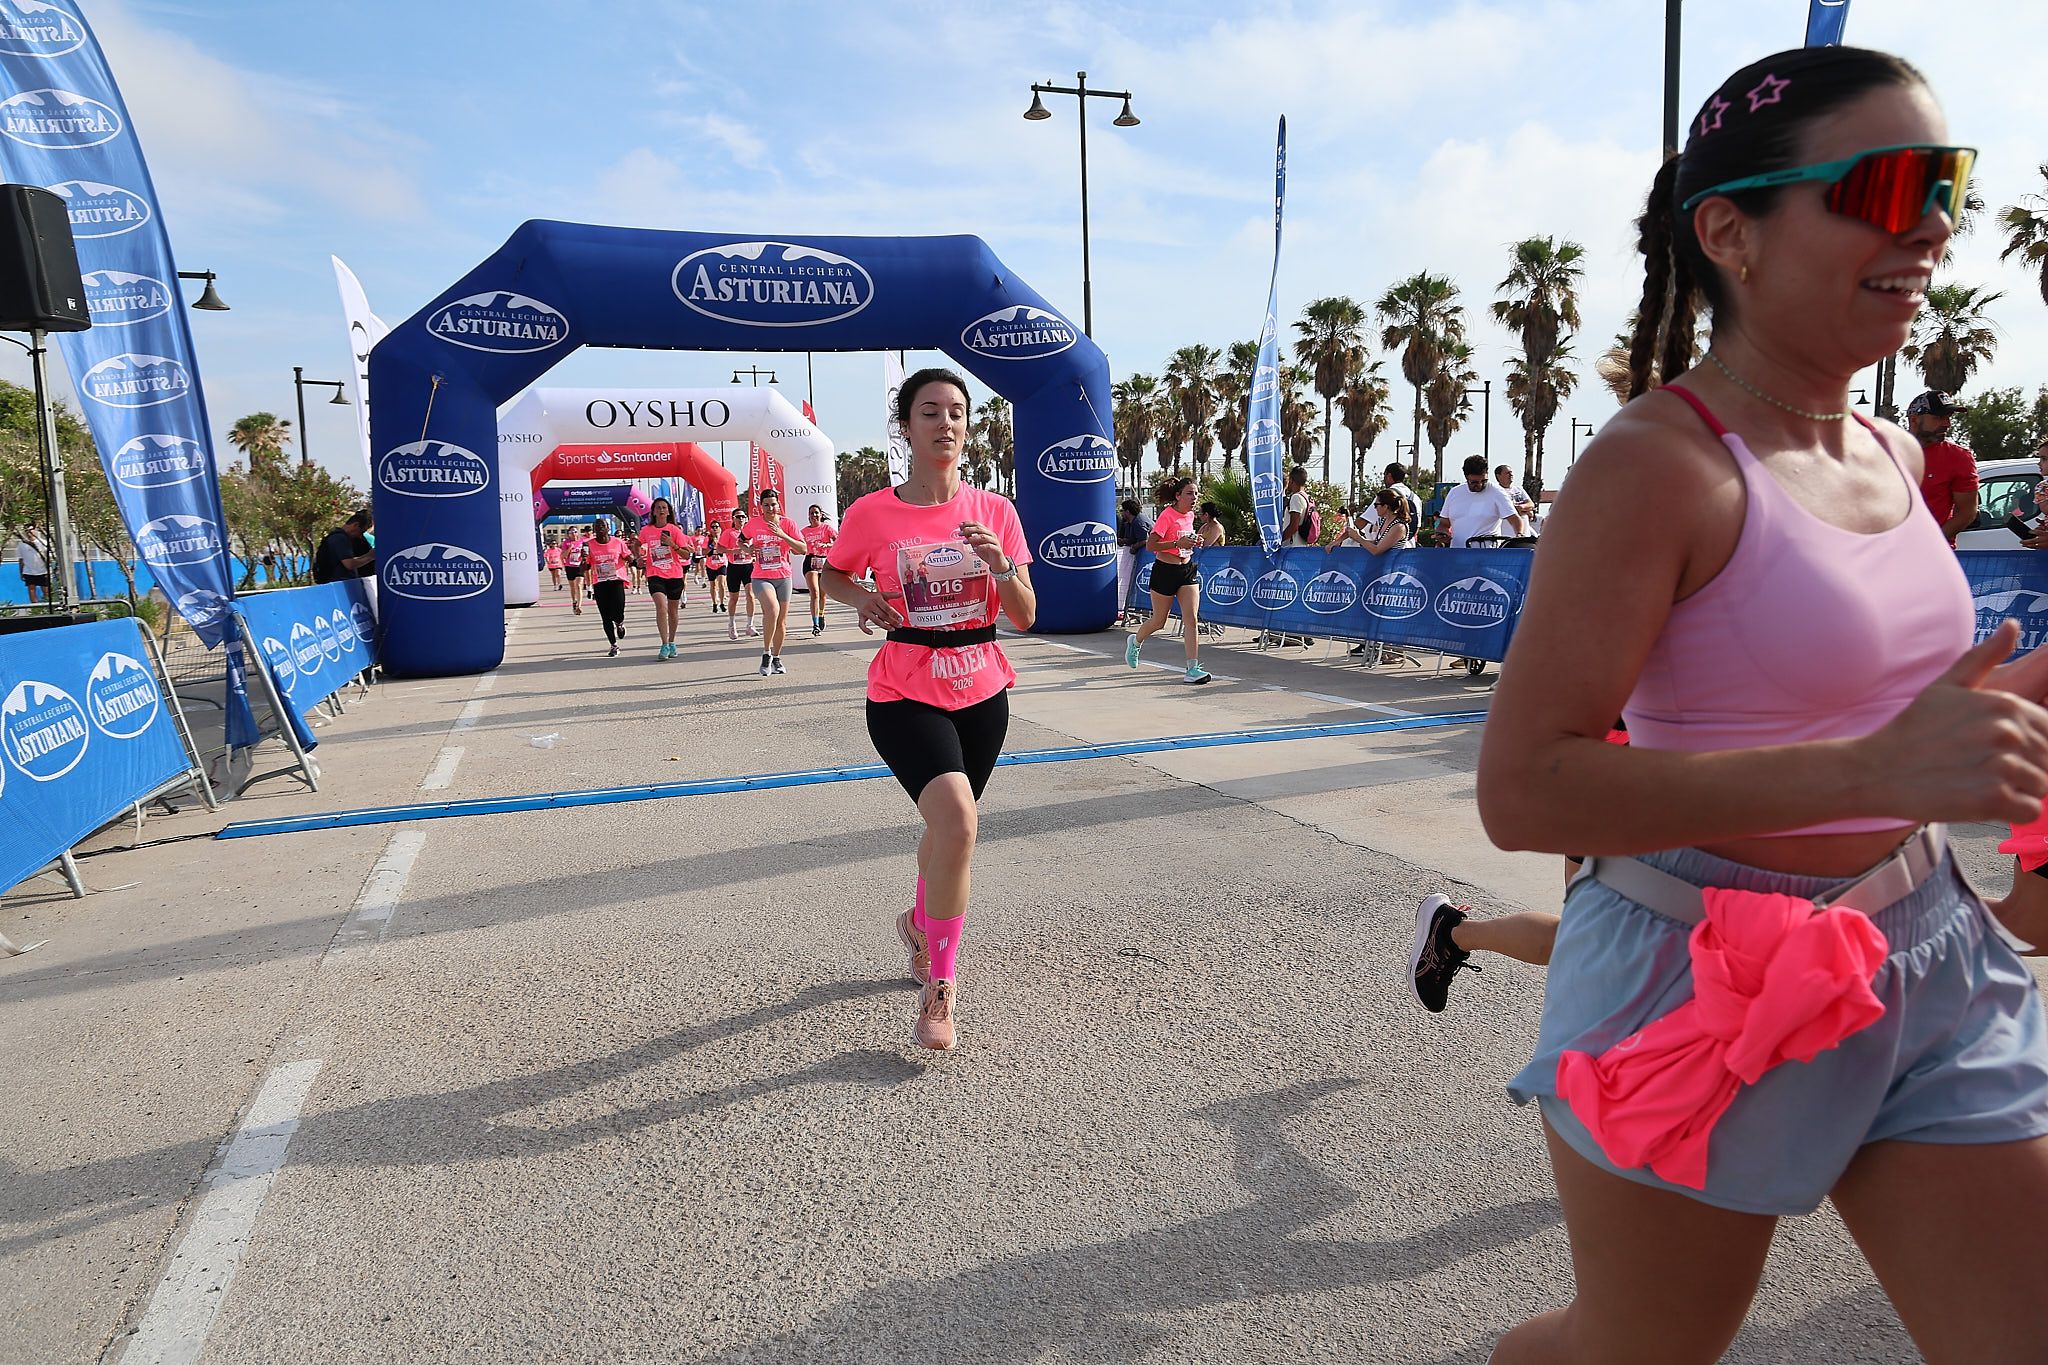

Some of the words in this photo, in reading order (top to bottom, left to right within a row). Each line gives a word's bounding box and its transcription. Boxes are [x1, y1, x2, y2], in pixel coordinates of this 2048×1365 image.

[719, 263, 784, 275] CENTRAL
[790, 266, 853, 277] LECHERA
[688, 264, 860, 305] ASTURIANA
[460, 310, 507, 318] CENTRAL
[511, 312, 557, 323] LECHERA
[435, 311, 559, 341] ASTURIANA
[989, 323, 1028, 332] CENTRAL
[971, 328, 1073, 348] ASTURIANA
[585, 399, 731, 429] OYSHO
[496, 433, 543, 444] OYSHO
[770, 428, 811, 439] OYSHO
[442, 460, 480, 468] LECHERA
[558, 453, 596, 467] Sports
[613, 451, 673, 463] Santander
[384, 461, 483, 484] ASTURIANA
[499, 492, 524, 502] SHO
[794, 484, 832, 495] OYSHO
[502, 552, 527, 561] SHO
[1046, 540, 1116, 558] ASTURIANA
[927, 553, 961, 565] ASTURIANA
[389, 564, 488, 586] ASTURIANA
[929, 579, 964, 595] 016
[1254, 583, 1293, 601] ASTURIANA
[1305, 586, 1351, 604] ASTURIANA
[1366, 588, 1421, 609] ASTURIANA
[1438, 593, 1503, 618] ASTURIANA
[930, 646, 987, 679] MUJER
[15, 713, 43, 732] CENTRAL
[44, 702, 73, 720] LECHERA
[9, 714, 86, 766] ASTURIANA
